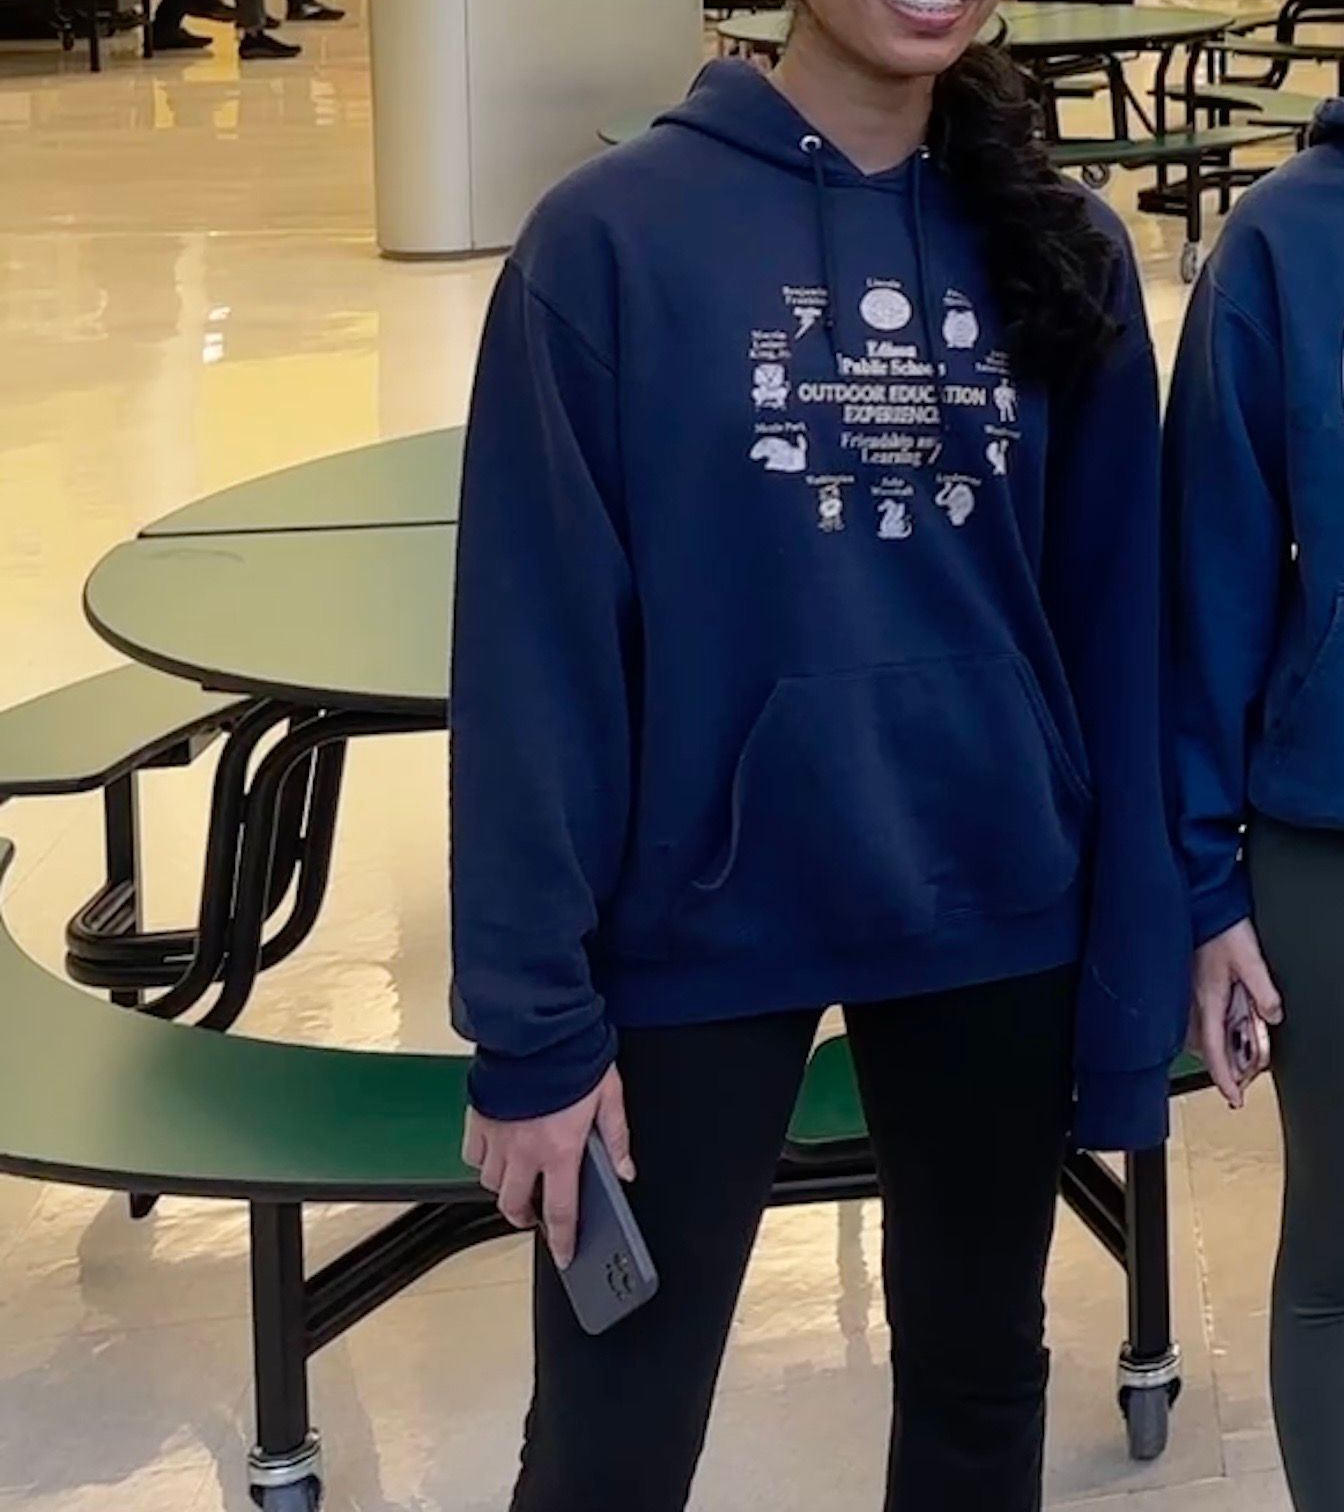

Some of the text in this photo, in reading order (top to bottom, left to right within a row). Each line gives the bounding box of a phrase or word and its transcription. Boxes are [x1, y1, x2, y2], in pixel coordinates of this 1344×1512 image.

[842, 357, 889, 377] Public
[798, 382, 988, 406] OUTDOOR EDUCTION
